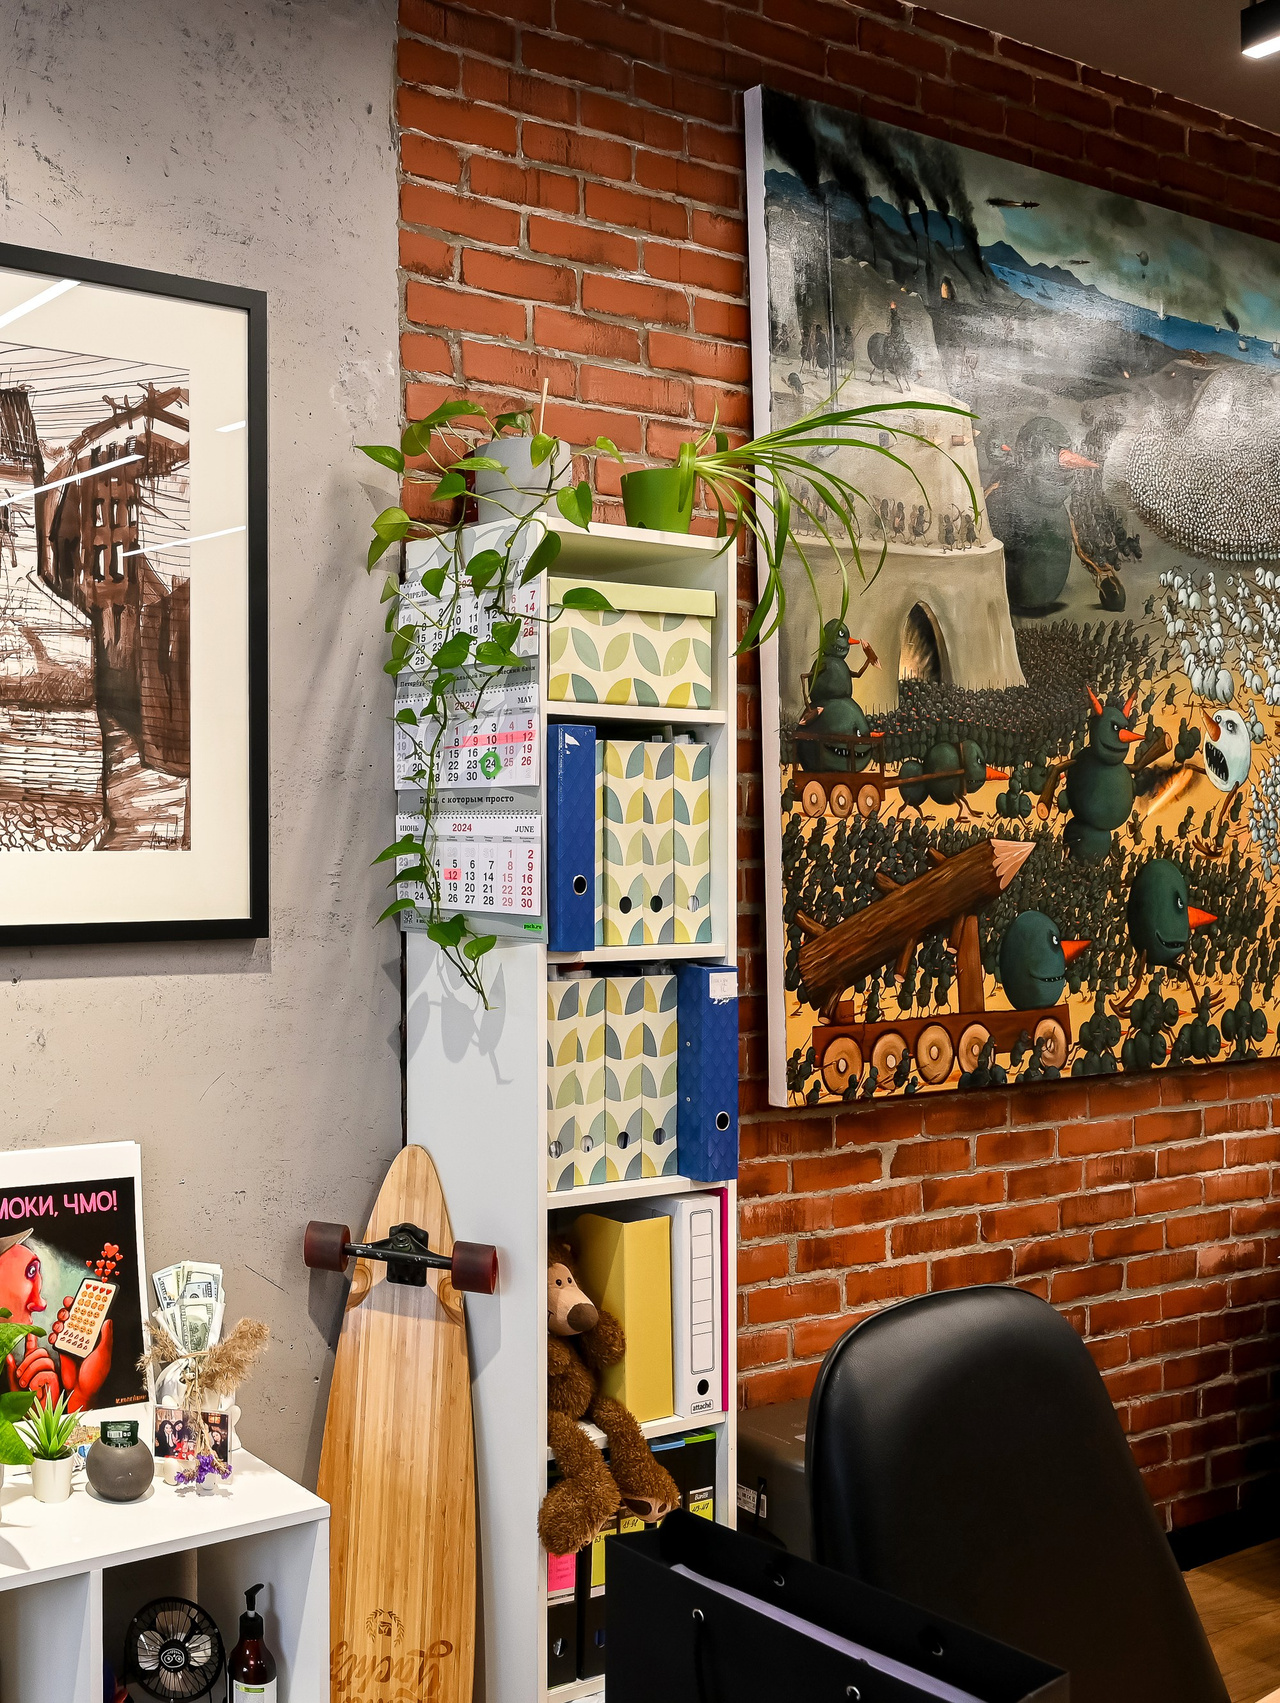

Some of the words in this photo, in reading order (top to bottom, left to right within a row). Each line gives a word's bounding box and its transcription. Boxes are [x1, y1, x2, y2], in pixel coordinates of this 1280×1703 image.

[402, 614, 411, 623] 14
[439, 608, 444, 617] 2
[456, 605, 461, 613] 3
[474, 602, 479, 611] 4
[511, 595, 516, 603] 6
[530, 590, 535, 600] 7
[469, 613, 478, 623] 11
[487, 610, 497, 620] 12
[525, 602, 535, 613] 14
[417, 634, 426, 643] 15
[433, 631, 442, 640] 16
[469, 625, 478, 634] 18
[433, 642, 442, 652] 23
[523, 626, 534, 637] 28
[415, 656, 425, 665] 29
[454, 700, 475, 711] 2024
[517, 696, 533, 704] MAY
[454, 726, 459, 735] 1
[473, 724, 479, 734] 2
[491, 723, 497, 732] 3
[509, 721, 514, 730] 4
[527, 719, 533, 729] 5
[454, 738, 459, 747] 8
[473, 737, 478, 746] 9
[487, 735, 497, 744] 10
[505, 734, 514, 743] 11
[523, 732, 533, 741] 12
[449, 750, 459, 759] 15
[468, 748, 478, 757] 16
[505, 745, 514, 755] 18
[523, 744, 532, 753] 19
[412, 763, 422, 772] 20
[448, 761, 459, 770] 22
[467, 760, 477, 769] 23
[486, 759, 496, 768] 24
[504, 758, 513, 767] 25
[521, 756, 531, 766] 26
[448, 773, 458, 781] 29
[467, 772, 477, 780] 30
[447, 797, 483, 805] которым
[485, 796, 514, 804] просто
[452, 823, 472, 832] 2024
[508, 849, 513, 858] 1
[527, 849, 534, 859] 2
[399, 857, 408, 866] 23
[435, 859, 440, 867] 4
[452, 860, 458, 868] 5
[470, 860, 475, 869] 6
[489, 861, 494, 869] 7
[507, 861, 513, 870] 8
[527, 862, 534, 871] 9
[448, 871, 458, 880] 12
[465, 872, 475, 880] 13
[483, 873, 494, 881] 14
[503, 873, 513, 882] 15
[522, 874, 532, 883] 16
[415, 881, 423, 889] 17
[448, 883, 458, 891] 19
[465, 883, 475, 892] 20
[483, 884, 493, 893] 21
[502, 885, 513, 894] 22
[521, 886, 532, 895] 23
[415, 892, 424, 900] 24
[448, 894, 458, 902] 26
[465, 895, 475, 904] 27
[483, 896, 494, 905] 28
[502, 897, 513, 906] 29
[521, 899, 532, 908] 30
[63, 1190, 118, 1215] ЧМО!
